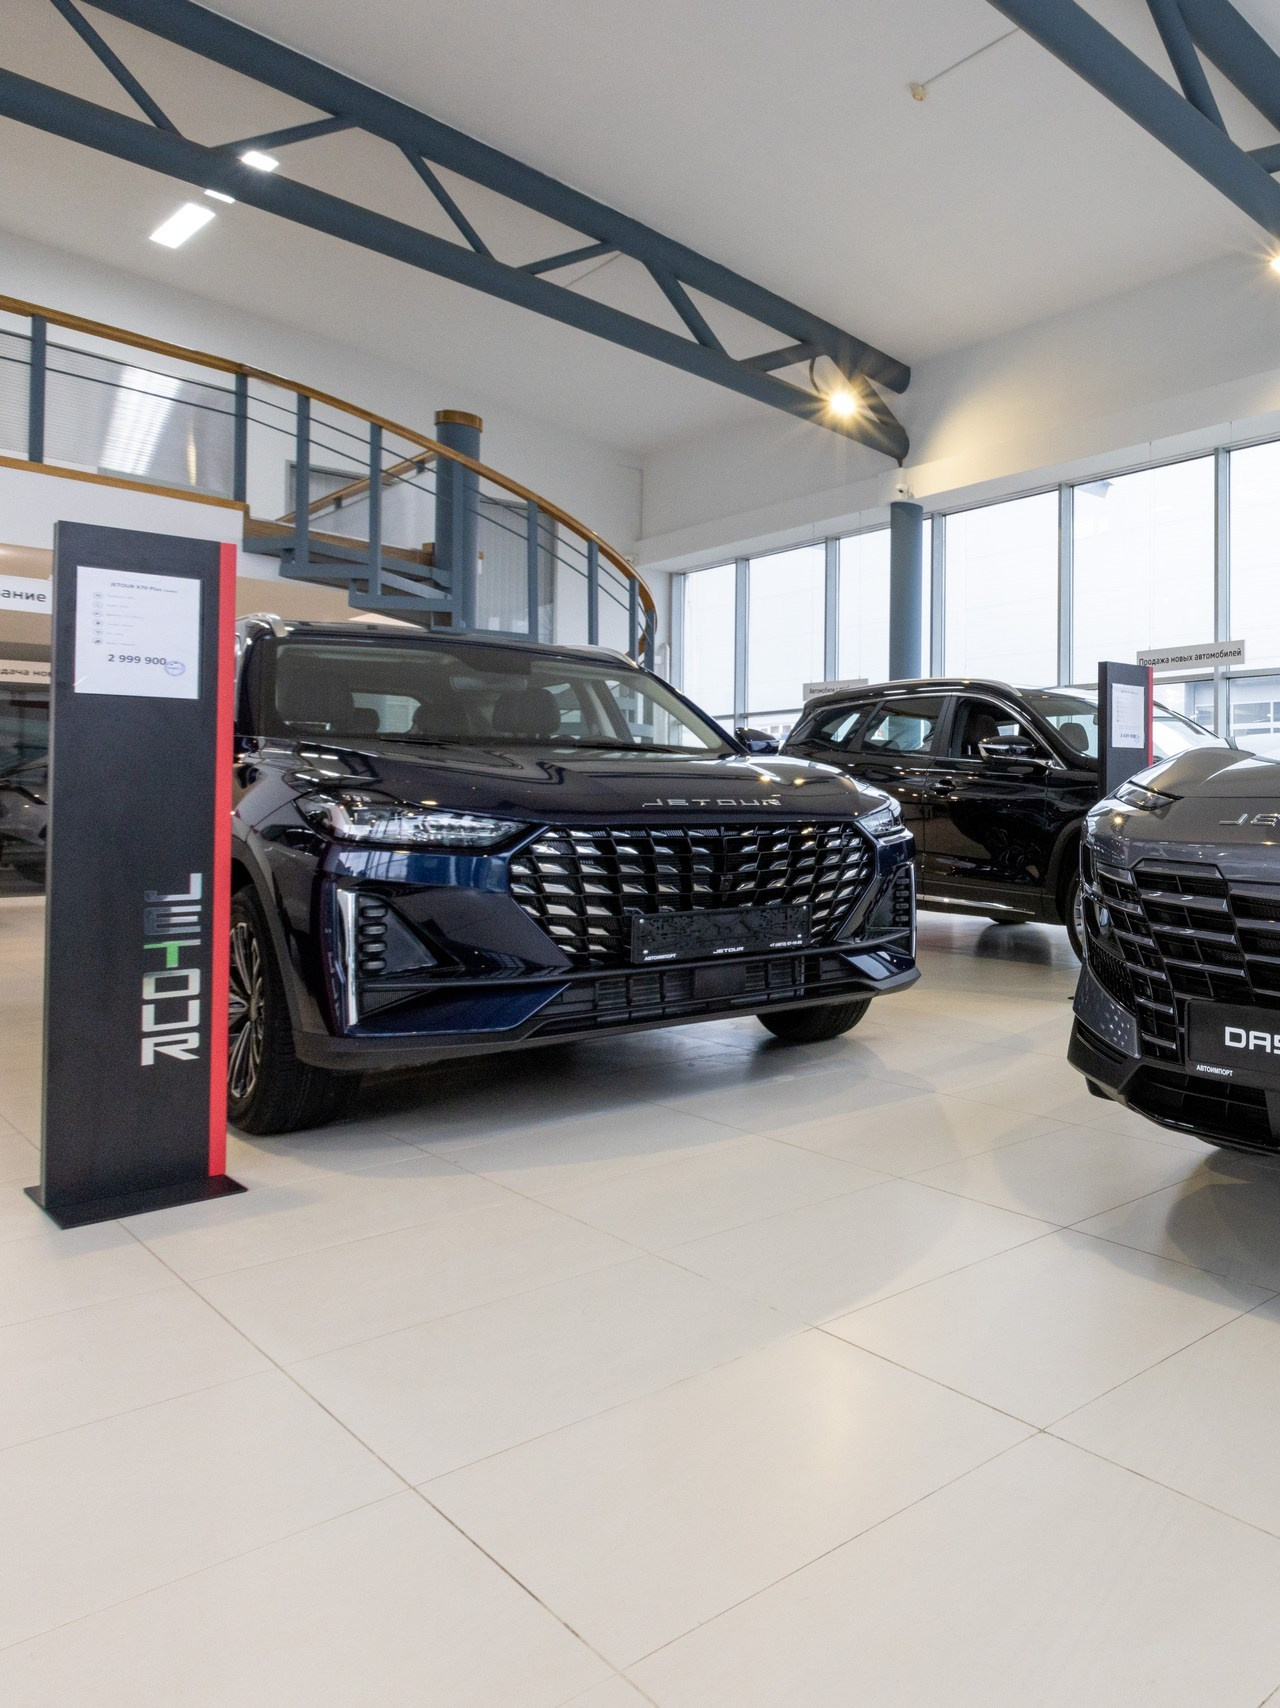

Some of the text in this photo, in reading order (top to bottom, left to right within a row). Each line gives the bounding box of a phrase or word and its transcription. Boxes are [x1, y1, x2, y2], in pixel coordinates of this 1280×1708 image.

[0, 589, 47, 602] ание
[107, 654, 167, 665] 2 999 900
[1139, 648, 1242, 667] Продажа новых автомобилей
[642, 798, 782, 808] JETOUR
[140, 872, 203, 1066] JETOUR
[1196, 1064, 1233, 1077] АВТОИМПОРТ
